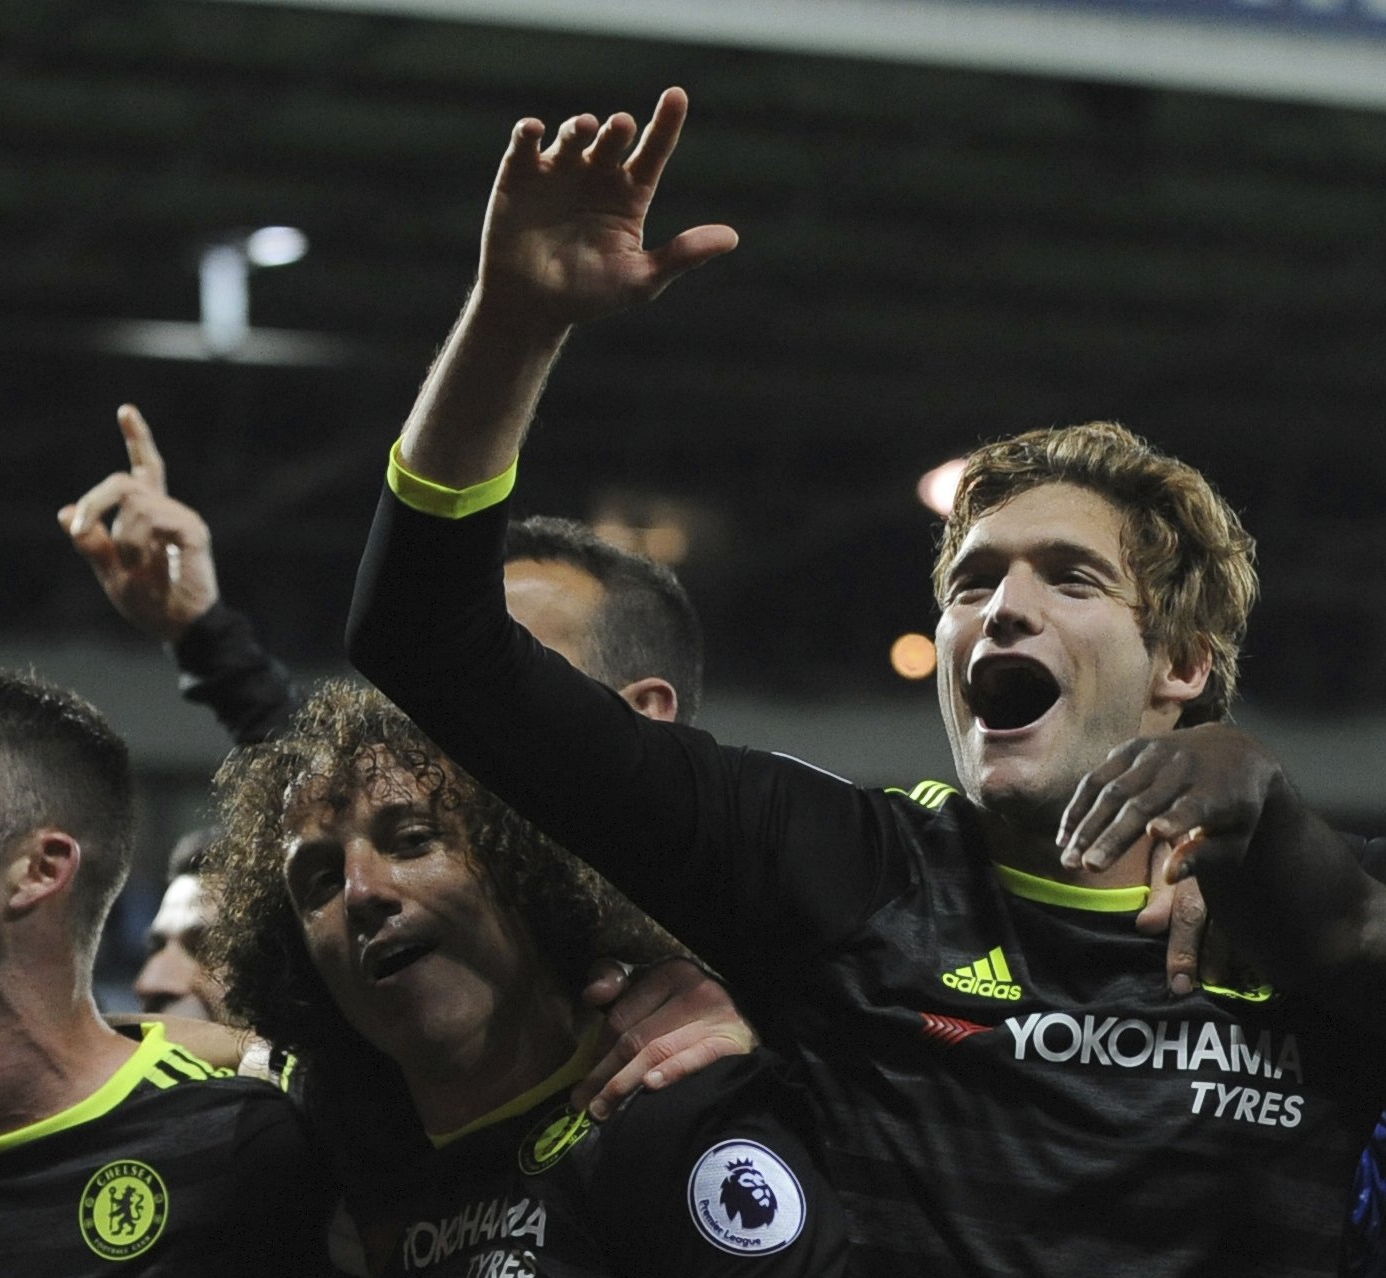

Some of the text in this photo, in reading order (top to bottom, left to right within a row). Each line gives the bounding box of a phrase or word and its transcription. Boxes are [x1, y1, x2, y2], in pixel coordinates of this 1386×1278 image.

[942, 972, 1022, 1001] adidas
[1004, 1011, 1304, 1085] YOKOHAMA
[1190, 1080, 1305, 1128] TYRES
[95, 1165, 154, 1188] CHELSEA
[699, 1199, 762, 1248] Premier League
